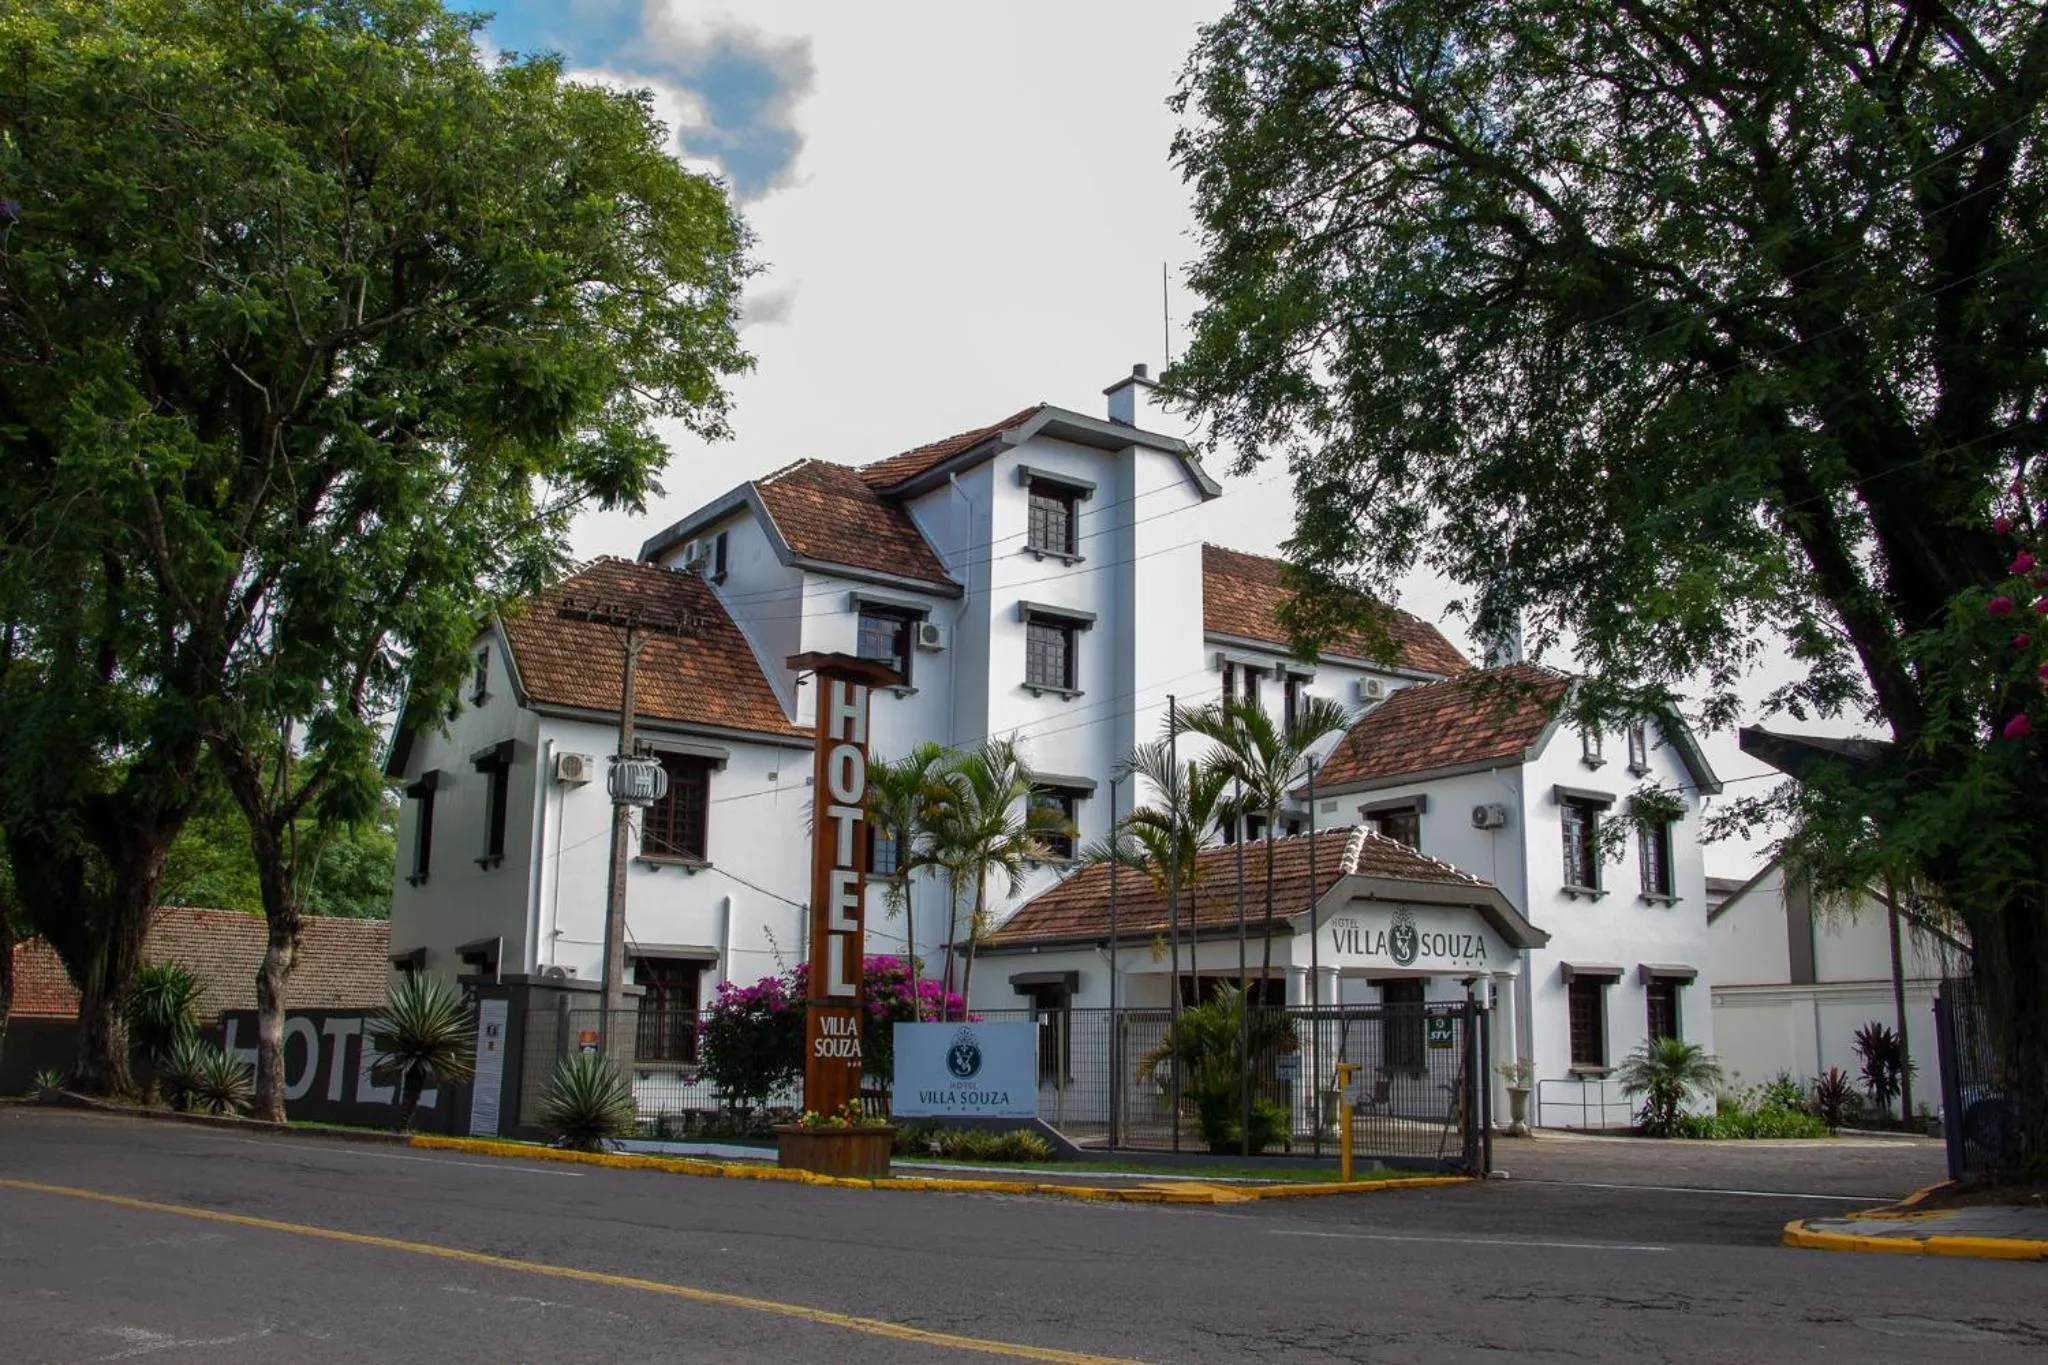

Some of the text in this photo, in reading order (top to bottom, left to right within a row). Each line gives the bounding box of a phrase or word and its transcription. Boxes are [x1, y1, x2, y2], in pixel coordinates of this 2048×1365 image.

[827, 680, 866, 998] HOTEL
[1331, 918, 1359, 929] HOTEL
[1332, 929, 1487, 959] VILLA SOUZA
[820, 1016, 858, 1036] VILLA
[1429, 1030, 1451, 1040] STV
[814, 1038, 862, 1058] SOUZA
[949, 1081, 978, 1090] HOTEL
[919, 1091, 1010, 1105] VILLA SOUZA
